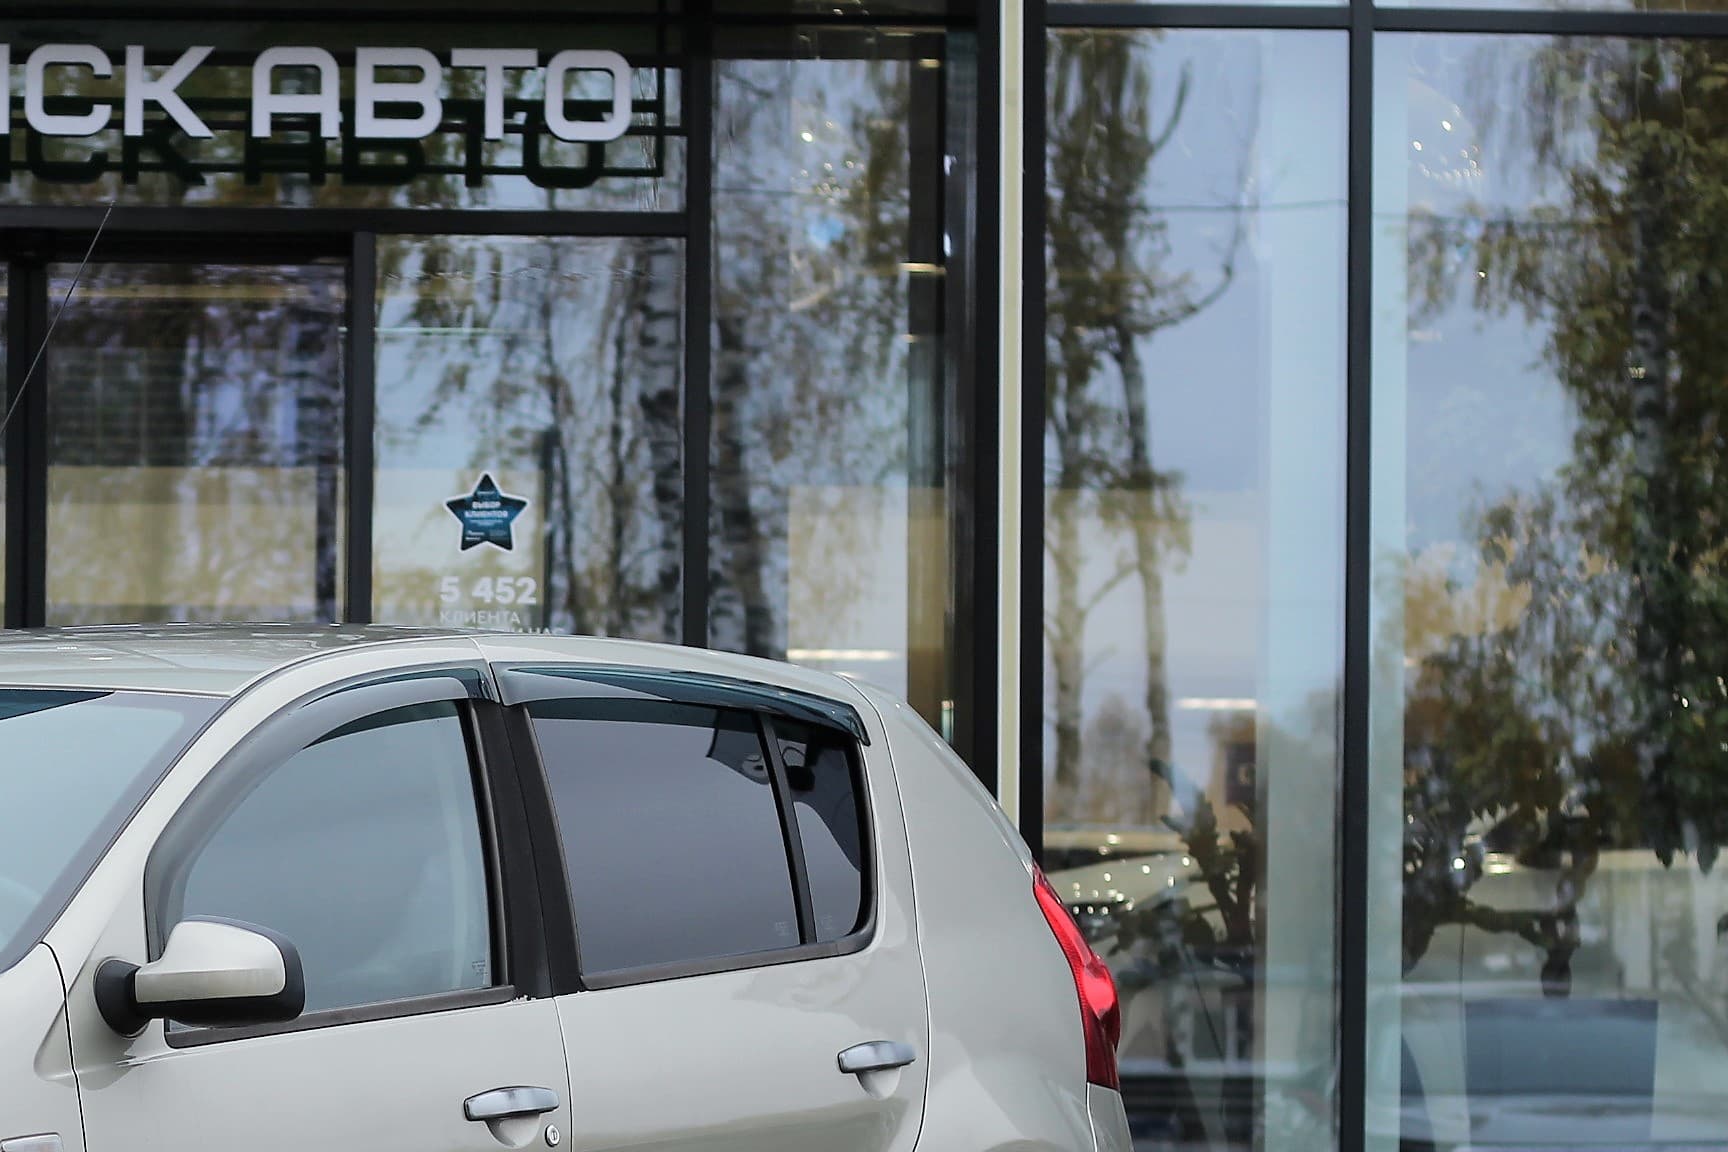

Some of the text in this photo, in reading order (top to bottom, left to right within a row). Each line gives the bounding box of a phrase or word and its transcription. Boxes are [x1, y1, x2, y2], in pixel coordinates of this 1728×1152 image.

[251, 45, 633, 142] АВТО
[440, 575, 537, 605] 5 452
[440, 610, 521, 624] КЛИЕНТА
